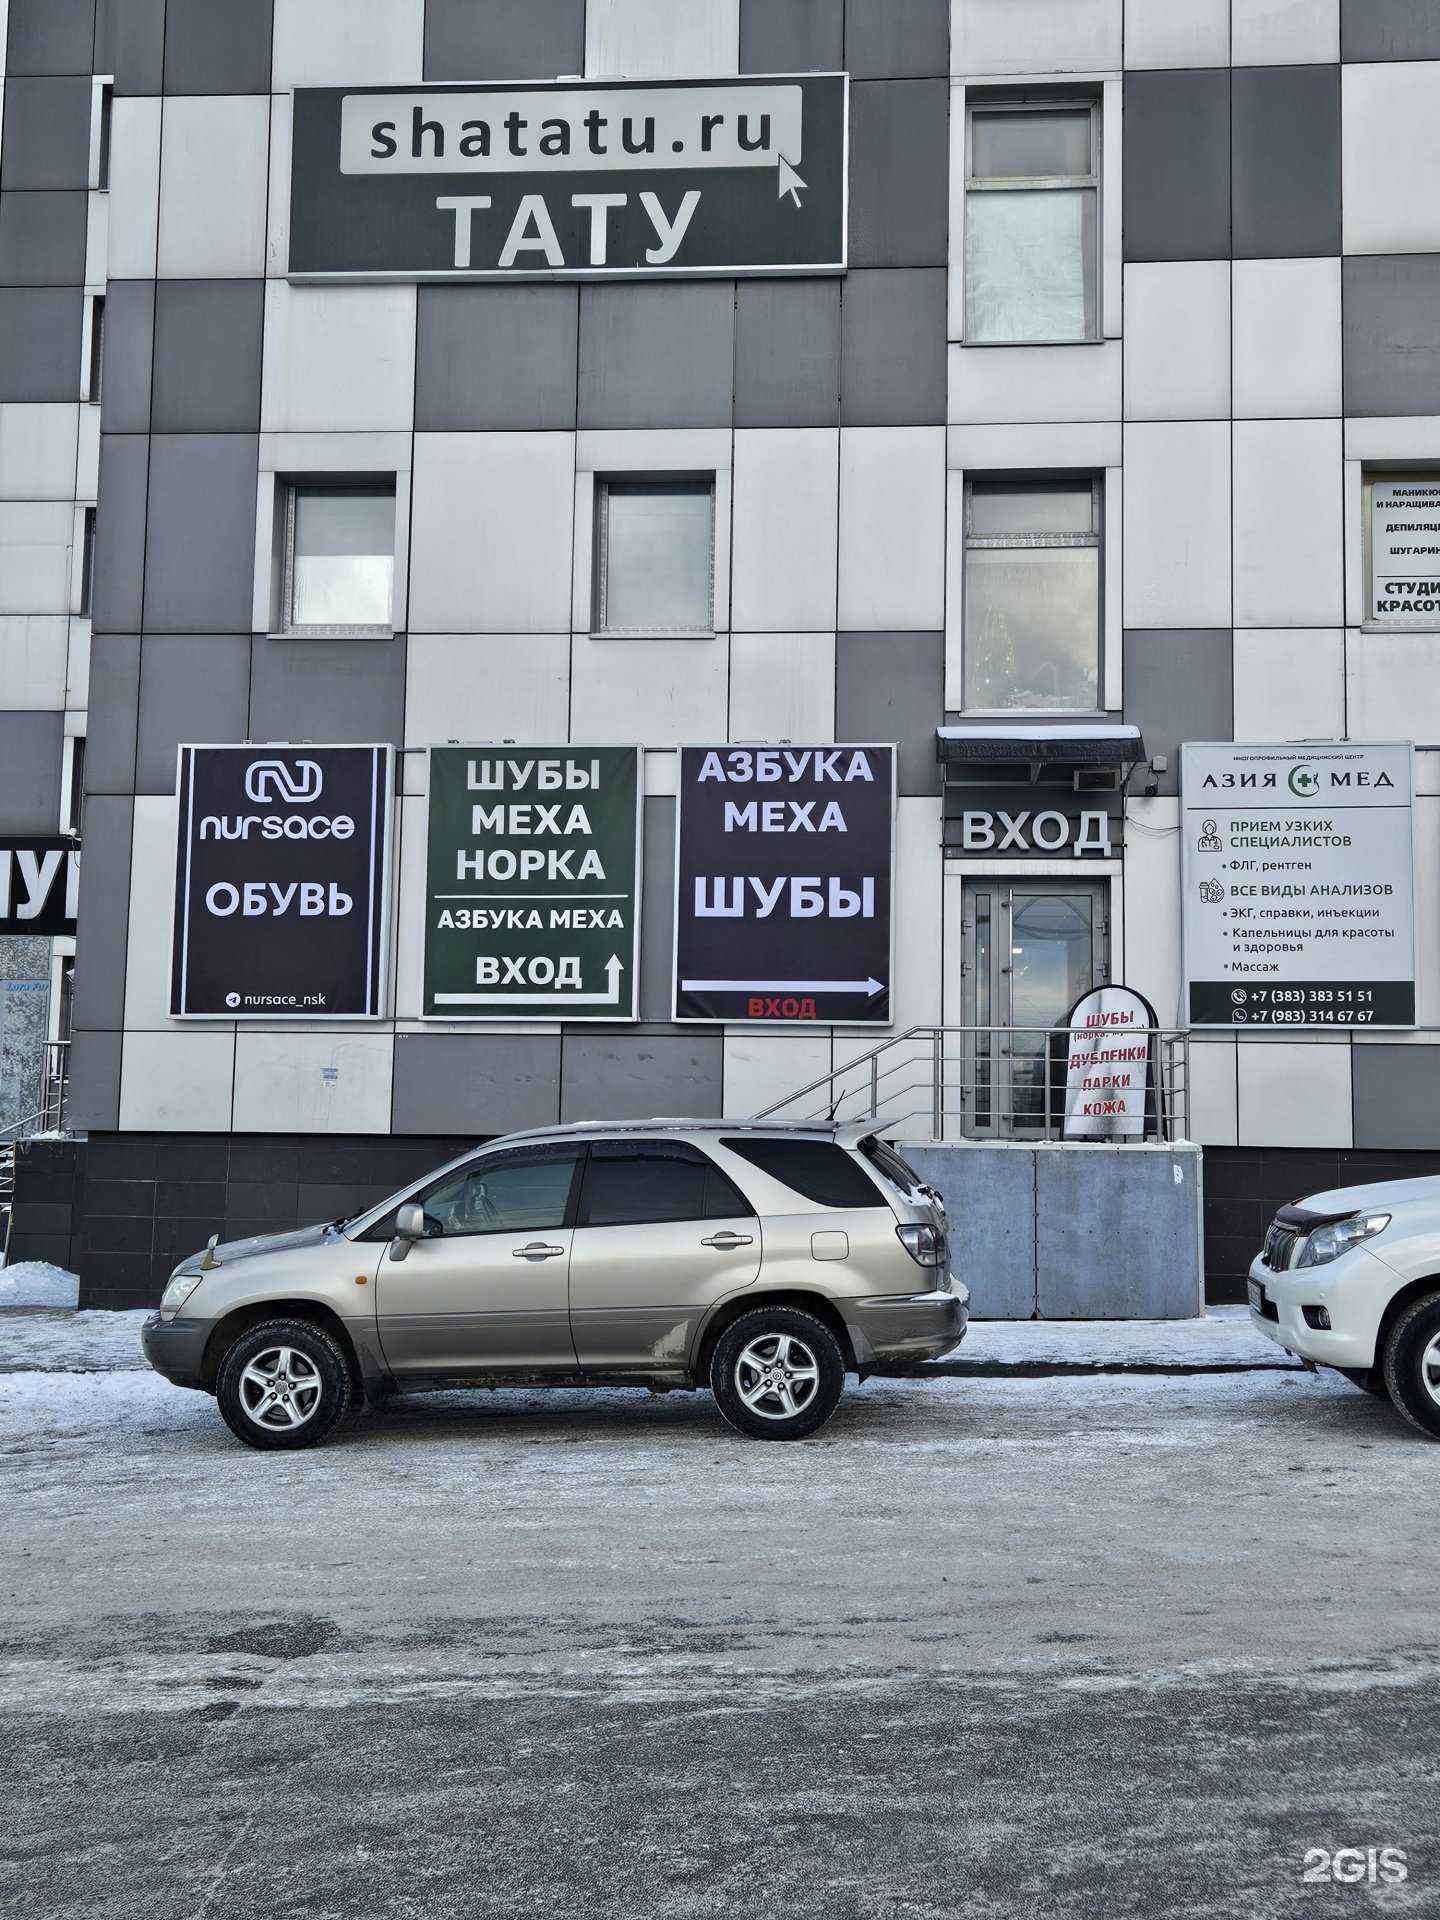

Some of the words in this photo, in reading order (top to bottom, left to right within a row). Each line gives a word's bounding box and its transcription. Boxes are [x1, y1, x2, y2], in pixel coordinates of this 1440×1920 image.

[370, 106, 772, 159] shatatu.ru
[435, 190, 702, 268] ТАТУ
[1392, 489, 1440, 497] МАНИКЮ
[467, 759, 600, 790] ШУБЫ
[697, 751, 875, 782] АЗБУКА
[1202, 773, 1277, 788] АЗИЯ
[1330, 771, 1395, 788] МЕД
[471, 804, 593, 835] МЕХА
[724, 801, 848, 832] МЕХА
[199, 815, 355, 840] nursace
[962, 810, 1112, 857] ВХОД
[1230, 821, 1281, 832] ПРИЕМ
[1285, 820, 1333, 832] УЗКИХ
[1230, 835, 1352, 849] СПЕЦИАЛИСТОВ
[456, 849, 607, 880] НОРКА
[1229, 860, 1259, 872] ФЛГ,
[1262, 861, 1312, 872] рентген
[205, 881, 353, 917] ОБУВЬ
[694, 876, 875, 918] ШУБЫ
[1230, 885, 1258, 896] ВСЕ
[1261, 885, 1306, 898] ВИДЫ
[1310, 884, 1393, 896] АНАЛИЗОВ
[437, 909, 544, 929] АЗБУКА
[549, 909, 625, 929] МЕХА
[1230, 908, 1256, 919] ЭКГ,
[1259, 908, 1314, 919] справки,
[1317, 908, 1380, 918] инъекции
[1232, 928, 1312, 939] Капельницы
[1315, 928, 1339, 939] для
[1342, 928, 1395, 940] красоты
[1233, 943, 1241, 952] и
[1244, 943, 1304, 954] здоровья
[476, 956, 583, 989] ВХОД
[1231, 962, 1280, 972] Массаж
[244, 991, 327, 1007] nursace_nsk
[1251, 990, 1267, 1002] +7
[1271, 989, 1306, 1003] (383)
[1309, 990, 1333, 1002] 383
[1337, 990, 1352, 1002] 51
[1357, 990, 1373, 1002] 51
[748, 998, 816, 1019] ВХОД
[1251, 1010, 1268, 1022] +7
[1271, 1009, 1306, 1023] (983)
[1309, 1010, 1334, 1022] 314
[1337, 1010, 1354, 1022] 67
[1357, 1010, 1374, 1022] 67
[1086, 1011, 1134, 1028] ШУБЫ
[1083, 1074, 1131, 1091] ПАРКИ
[1083, 1100, 1126, 1115] КОЖА
